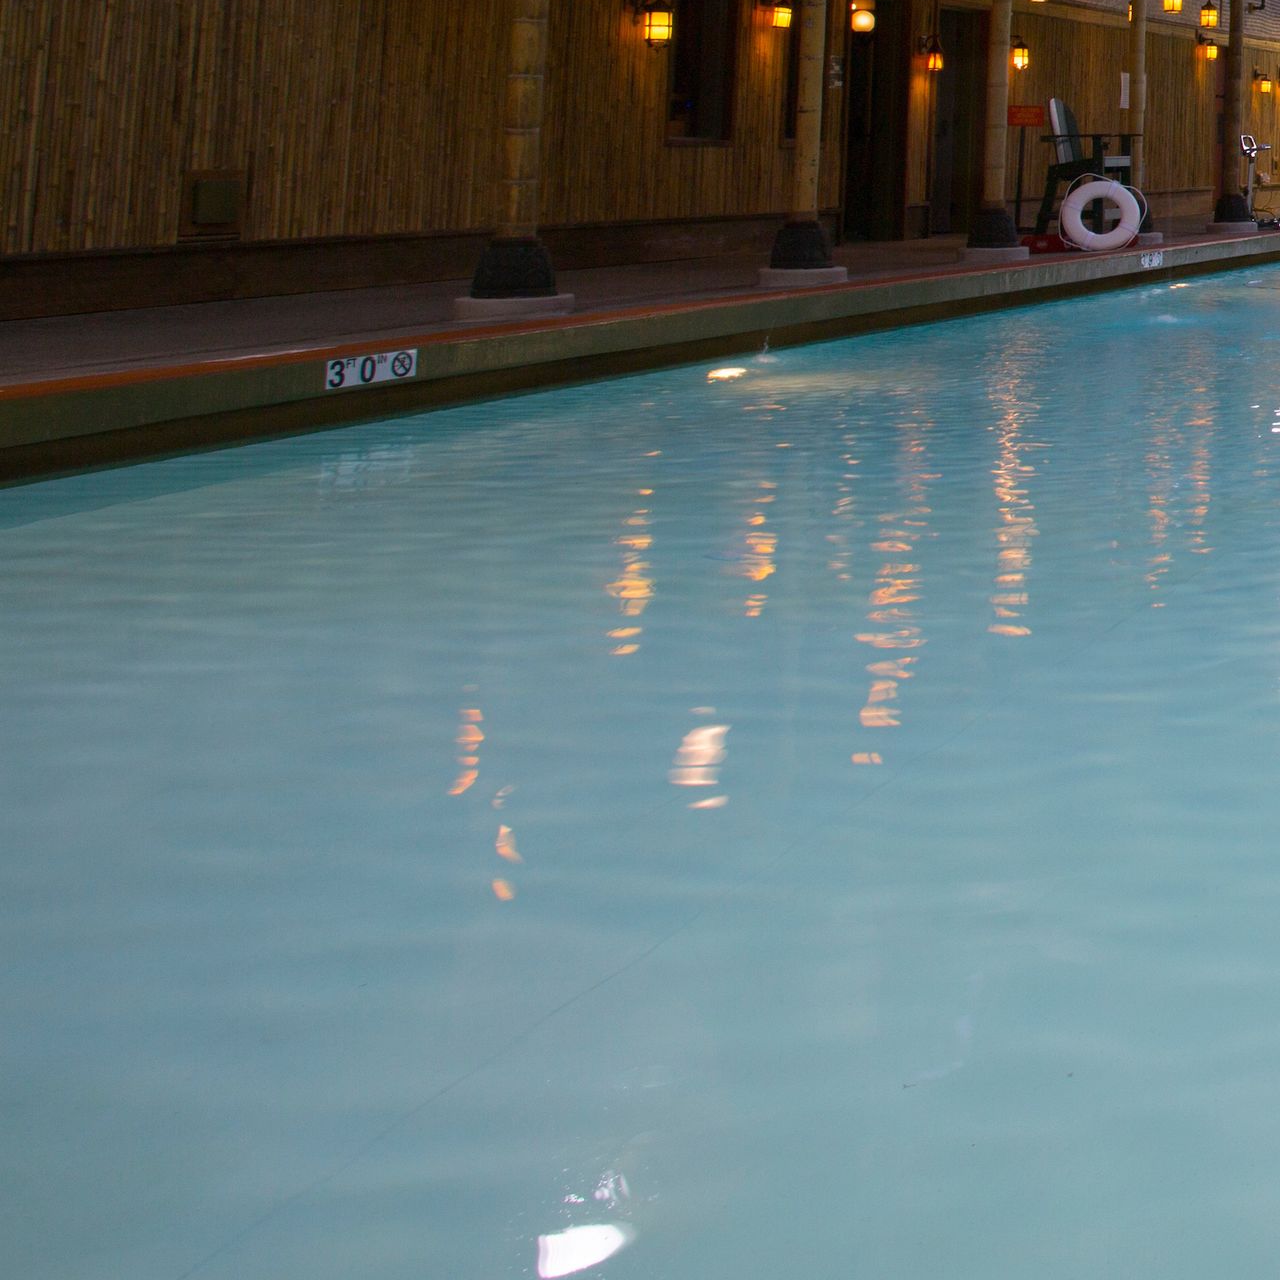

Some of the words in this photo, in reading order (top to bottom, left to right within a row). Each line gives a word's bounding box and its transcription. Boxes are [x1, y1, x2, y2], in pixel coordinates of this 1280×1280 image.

[329, 360, 345, 388] 3
[346, 358, 358, 368] FT
[361, 357, 376, 383] 0
[377, 355, 388, 364] IN
